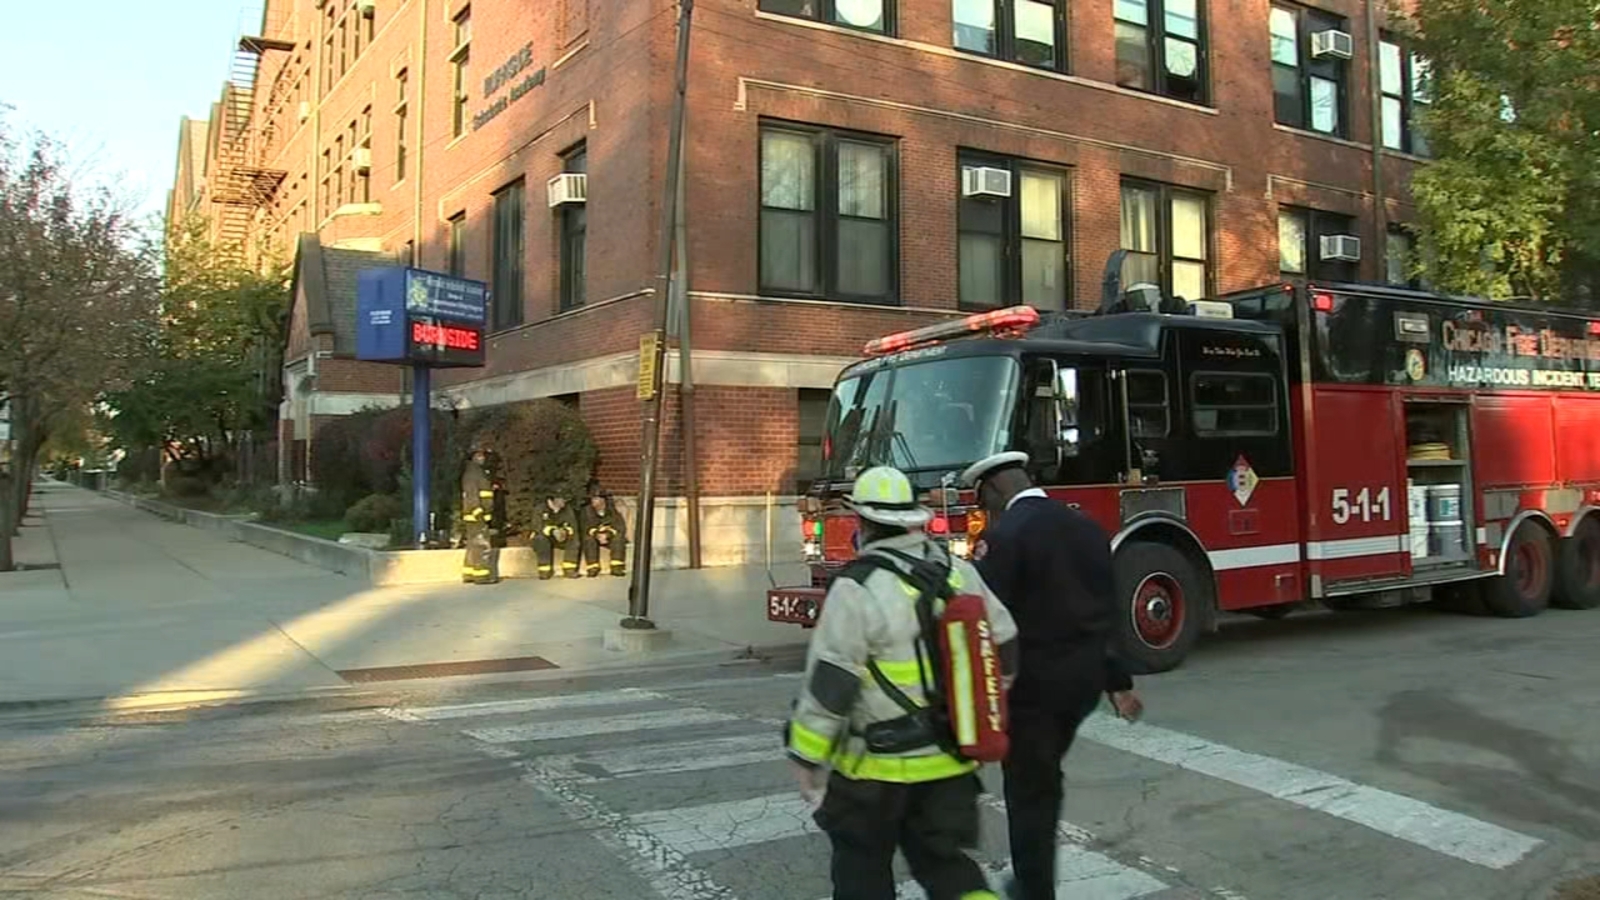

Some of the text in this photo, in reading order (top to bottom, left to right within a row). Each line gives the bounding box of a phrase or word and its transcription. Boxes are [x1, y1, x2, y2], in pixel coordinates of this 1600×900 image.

[1448, 365, 1529, 385] HAZARDOUS
[1532, 370, 1585, 387] INCIDENT
[1332, 486, 1391, 525] 5-1-1
[977, 619, 1002, 732] SAFETY
